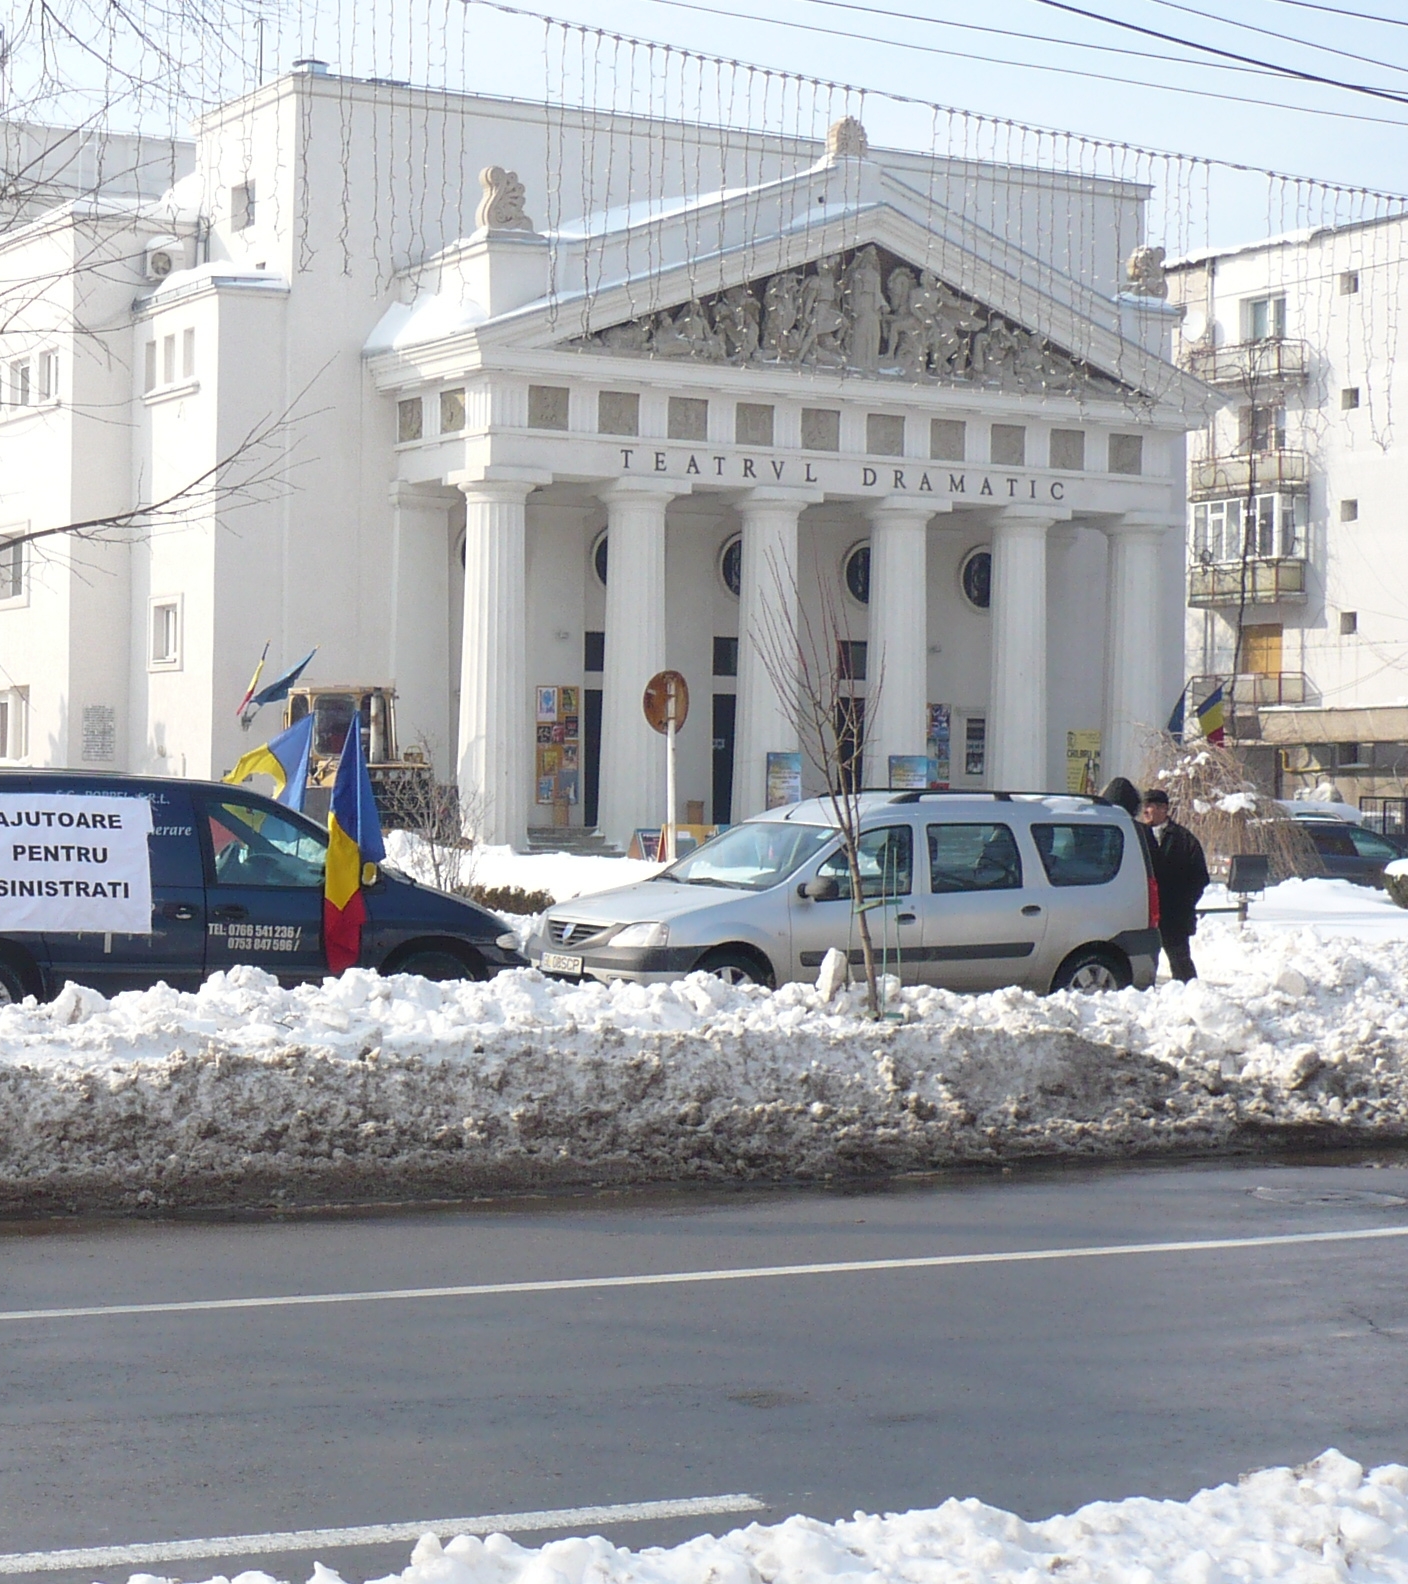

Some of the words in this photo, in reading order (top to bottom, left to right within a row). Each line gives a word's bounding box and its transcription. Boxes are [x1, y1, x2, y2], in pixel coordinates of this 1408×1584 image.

[620, 449, 818, 483] TEATRVL
[862, 467, 1065, 501] DRAMATIC
[12, 844, 109, 864] PENTRU
